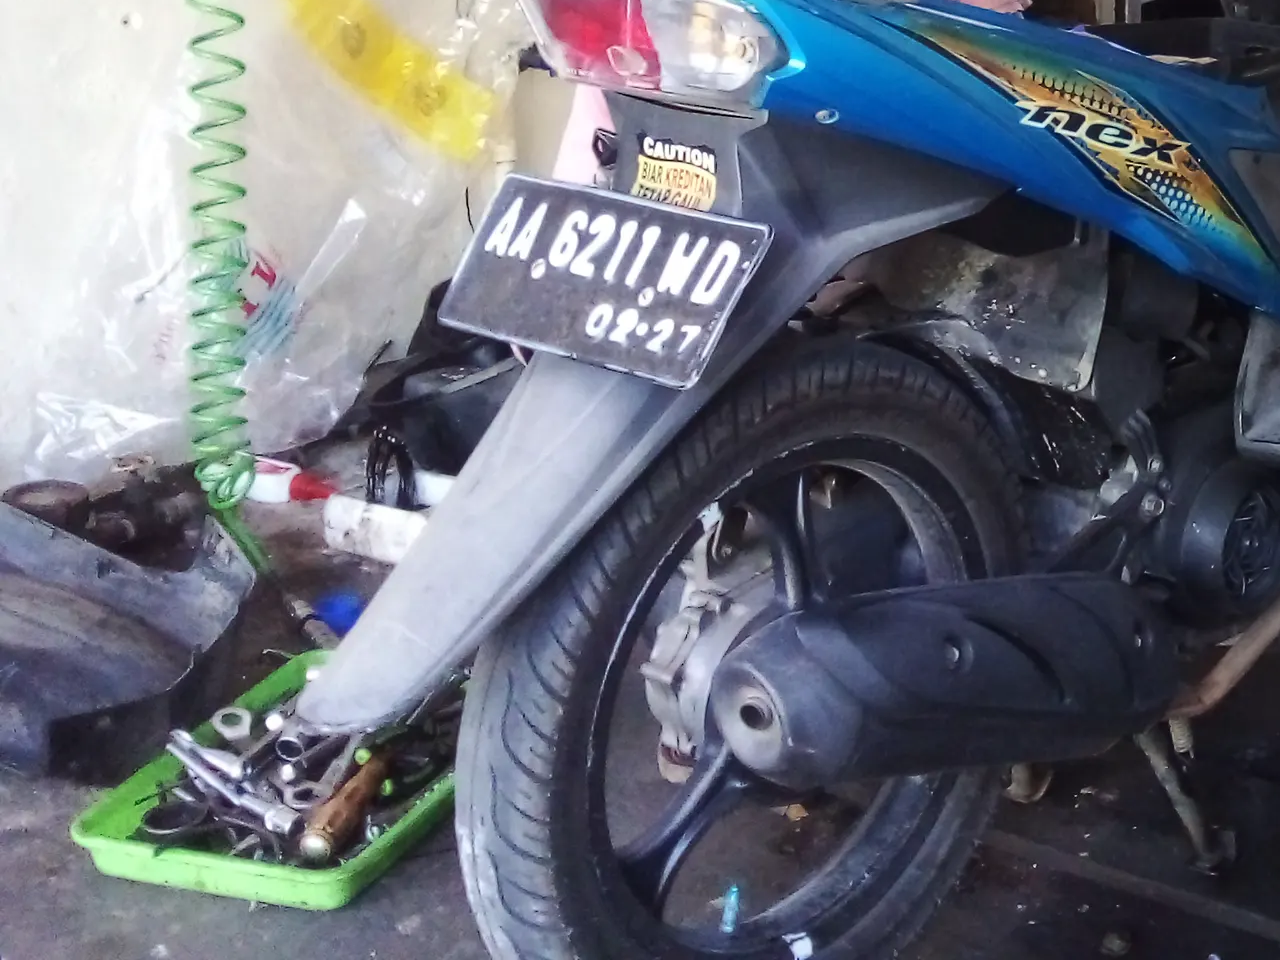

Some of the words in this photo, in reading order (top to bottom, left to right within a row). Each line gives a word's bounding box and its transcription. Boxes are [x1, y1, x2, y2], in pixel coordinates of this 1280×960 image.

[643, 136, 715, 173] CAUTION
[1016, 101, 1191, 169] nex
[642, 161, 663, 183] BIAR
[665, 167, 713, 199] KREDITAN
[484, 196, 548, 260] AA
[549, 209, 662, 288] 6211
